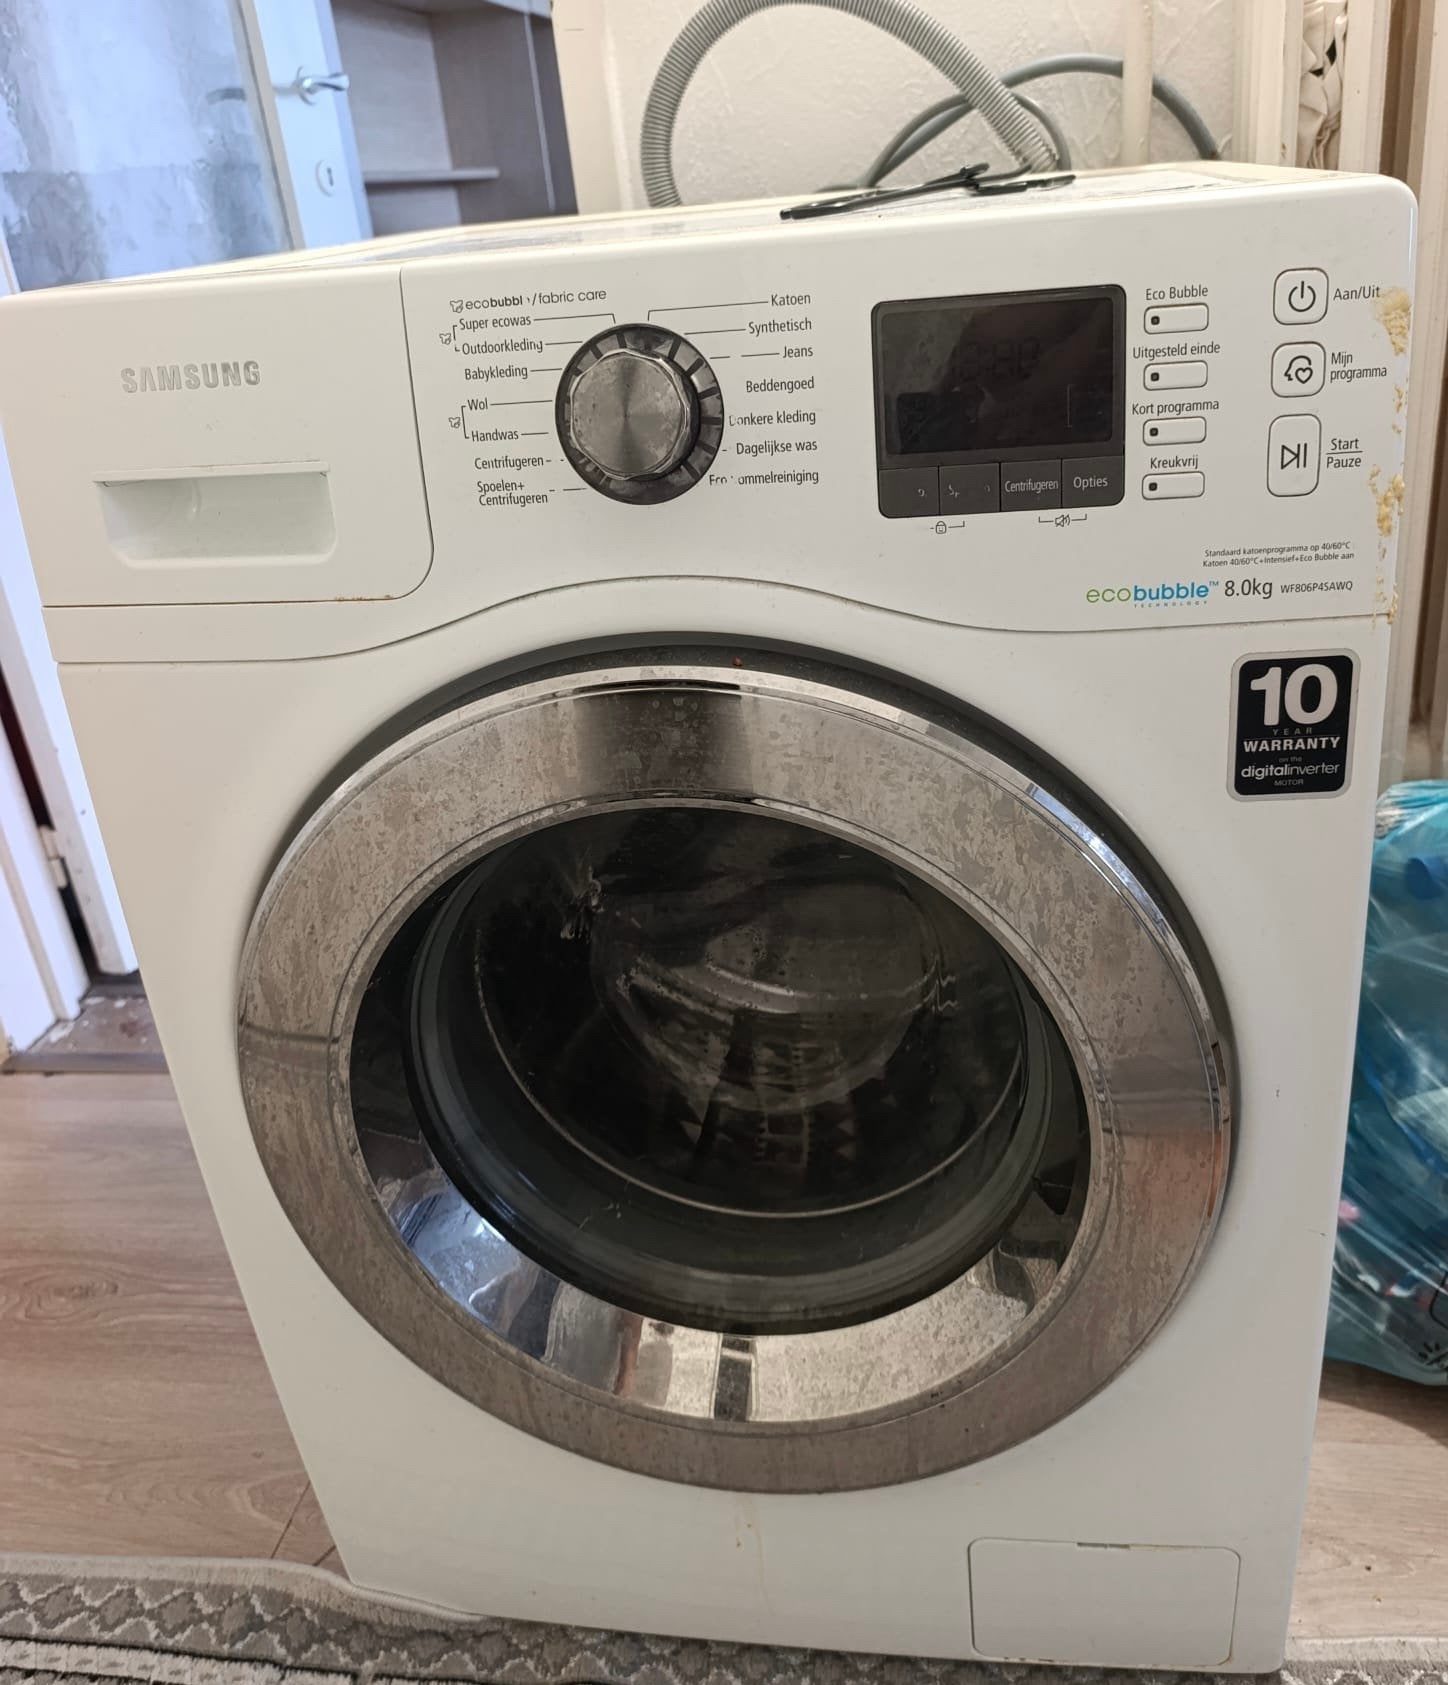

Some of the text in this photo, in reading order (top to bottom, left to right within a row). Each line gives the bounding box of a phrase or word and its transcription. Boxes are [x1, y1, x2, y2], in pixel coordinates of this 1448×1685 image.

[577, 290, 607, 301] care
[771, 293, 811, 307] Katoen
[1145, 284, 1209, 301] Eco Bubble
[1333, 285, 1380, 301] Aan/Uit
[459, 316, 532, 333] Super ecowas
[748, 317, 813, 337] Synthetisch
[462, 338, 543, 355] Outdoorkleding
[783, 346, 814, 359] Jeans
[1132, 341, 1221, 361] Uitgesteld einde
[1331, 351, 1353, 366] Mijn
[120, 360, 261, 394] SAMSUNG
[464, 364, 528, 382] Babykleding
[1330, 367, 1387, 384] programma
[746, 376, 815, 394] Beddengoed
[467, 398, 488, 411] Wol
[1132, 400, 1219, 417] Kort programma
[729, 409, 816, 426] Donkere kleding
[471, 428, 519, 442] Handwas
[736, 440, 818, 457] Dagelijkse was
[1330, 438, 1359, 451] Start
[474, 455, 544, 471] Centrifugeren
[1150, 455, 1199, 470] Kreukvrij
[1326, 456, 1362, 470] Pauze
[477, 480, 525, 495] Spoelen+
[1004, 478, 1059, 494] Centrifugeren
[1073, 476, 1109, 489] Opties
[479, 493, 548, 508] Centrifugeren
[1204, 549, 1241, 557] Standaard
[1243, 545, 1308, 555] katoenprogramma
[1310, 544, 1319, 552] op
[1203, 558, 1228, 568] Katoen
[1315, 553, 1339, 561] Bubble
[1340, 552, 1355, 560] aan
[1224, 577, 1273, 600] 8.0kg
[1250, 663, 1338, 727] 10
[1272, 727, 1313, 736] YEAR
[1243, 736, 1340, 753] WARRANTY
[1241, 762, 1340, 780] digitalinverter
[1273, 778, 1304, 786] MOTOR
